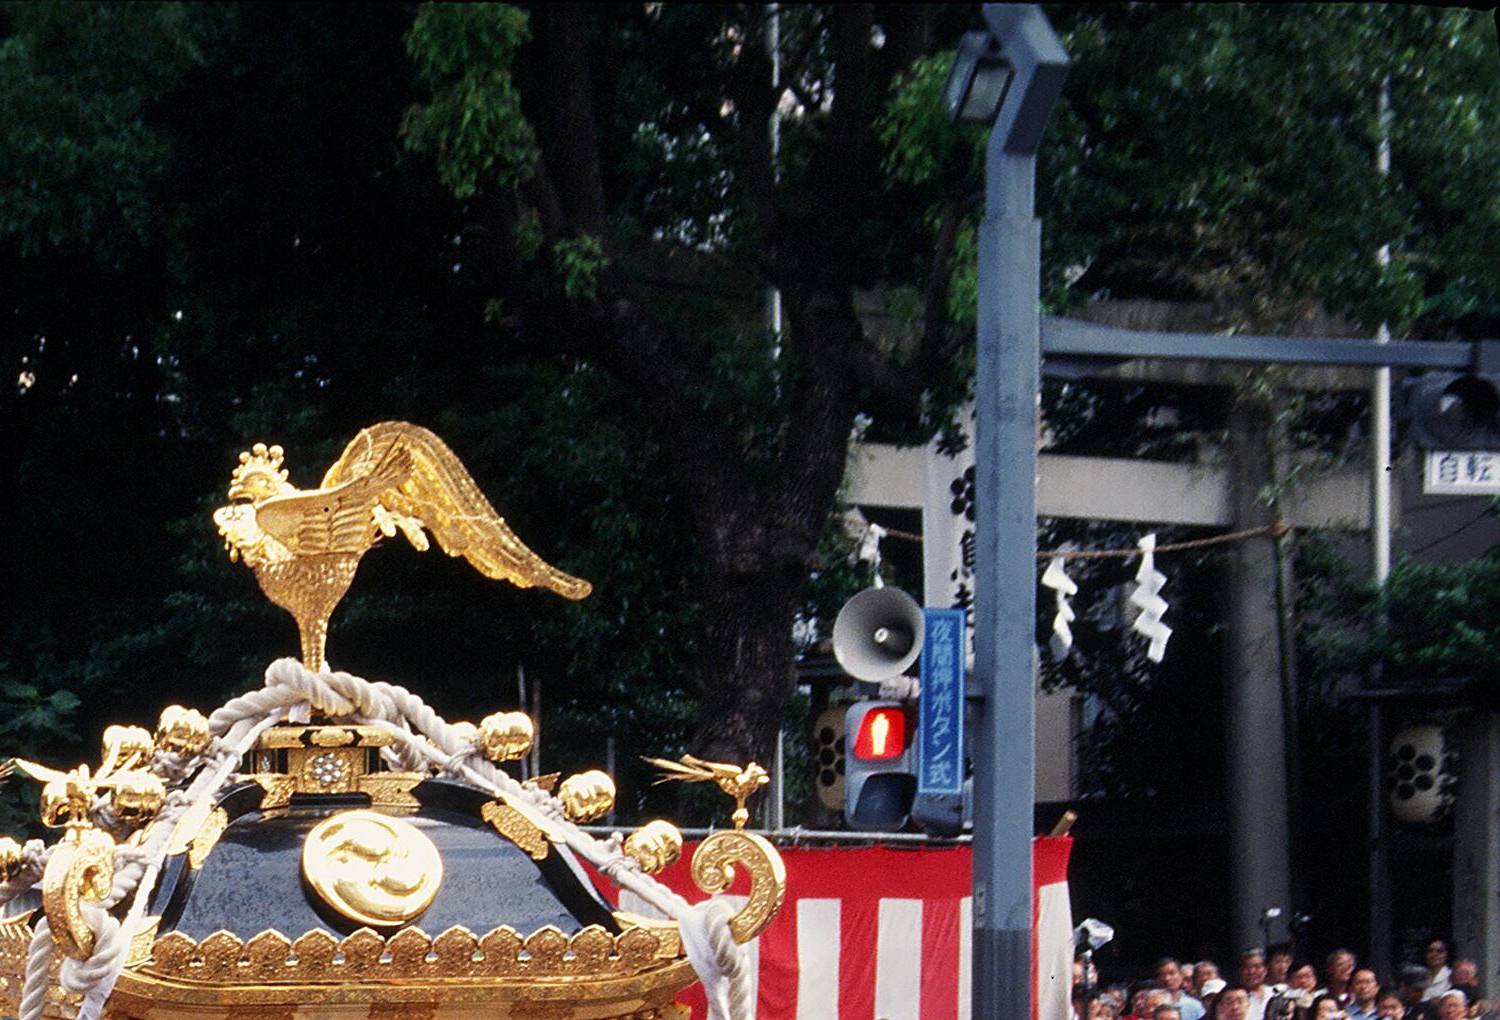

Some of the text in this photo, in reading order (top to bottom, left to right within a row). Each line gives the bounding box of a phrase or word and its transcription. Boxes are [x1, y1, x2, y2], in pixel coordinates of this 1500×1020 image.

[929, 619, 954, 785] 夜間押ボタン式
